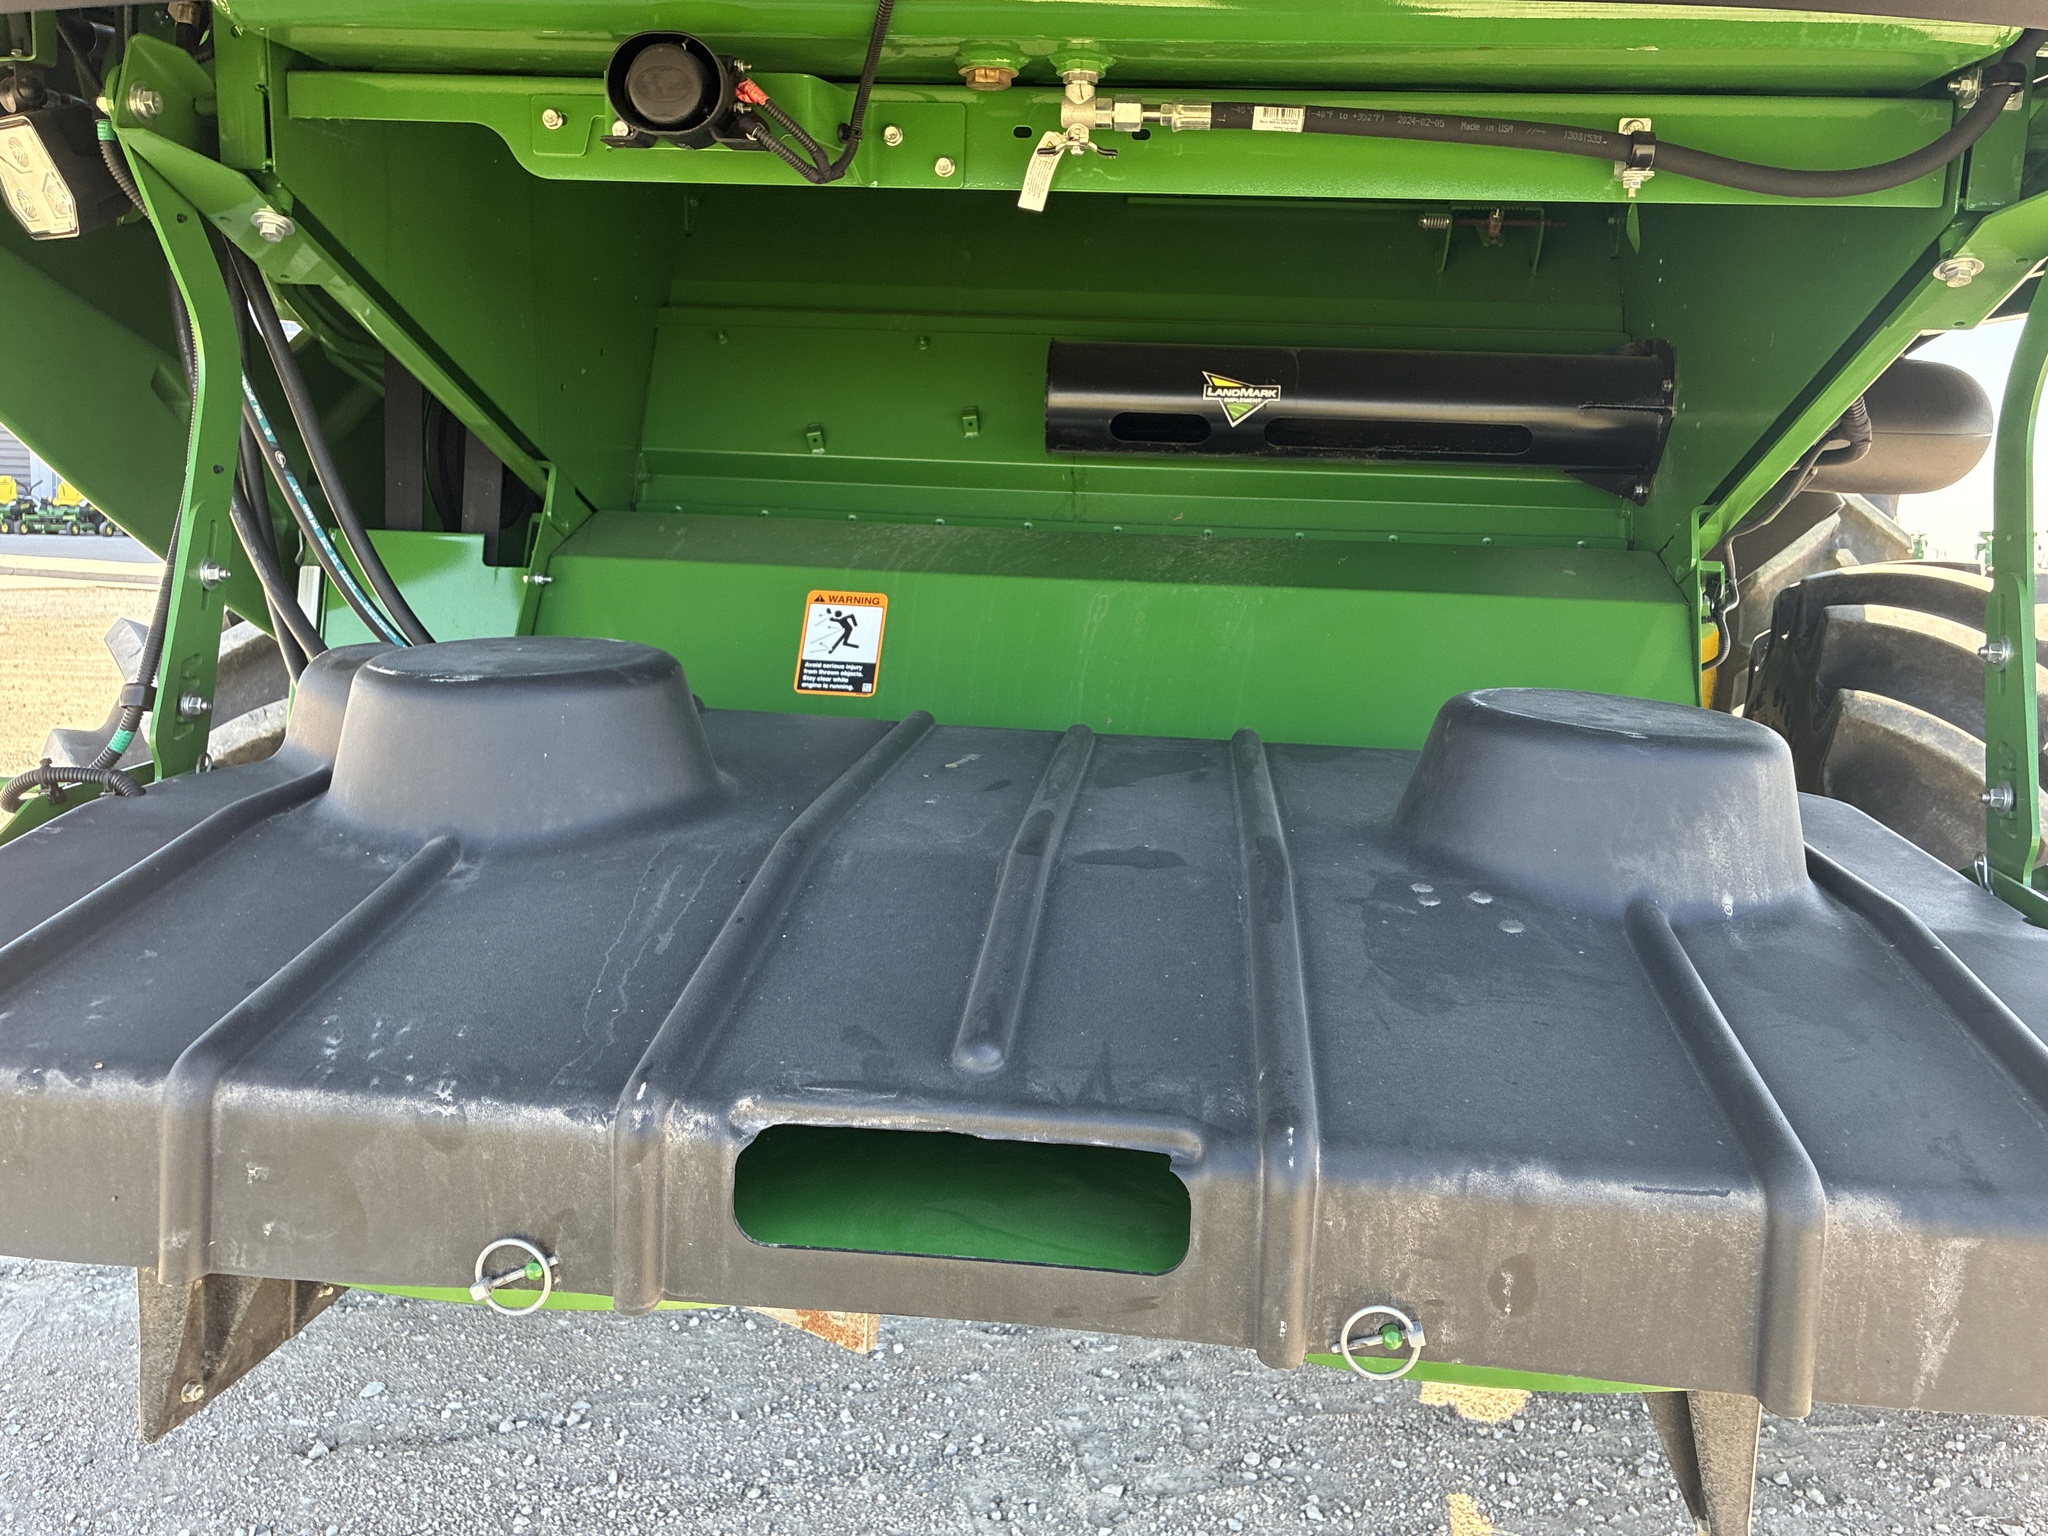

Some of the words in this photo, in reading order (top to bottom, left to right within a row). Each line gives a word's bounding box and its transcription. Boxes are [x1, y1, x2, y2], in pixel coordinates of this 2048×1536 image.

[1339, 112, 1349, 120] to
[1397, 115, 1446, 128] 2024-02-05
[1460, 121, 1481, 131] Made
[1485, 123, 1494, 132] in
[1498, 124, 1514, 134] USA
[828, 595, 880, 605] WARNING
[846, 663, 863, 671] injury
[801, 682, 822, 690] engine
